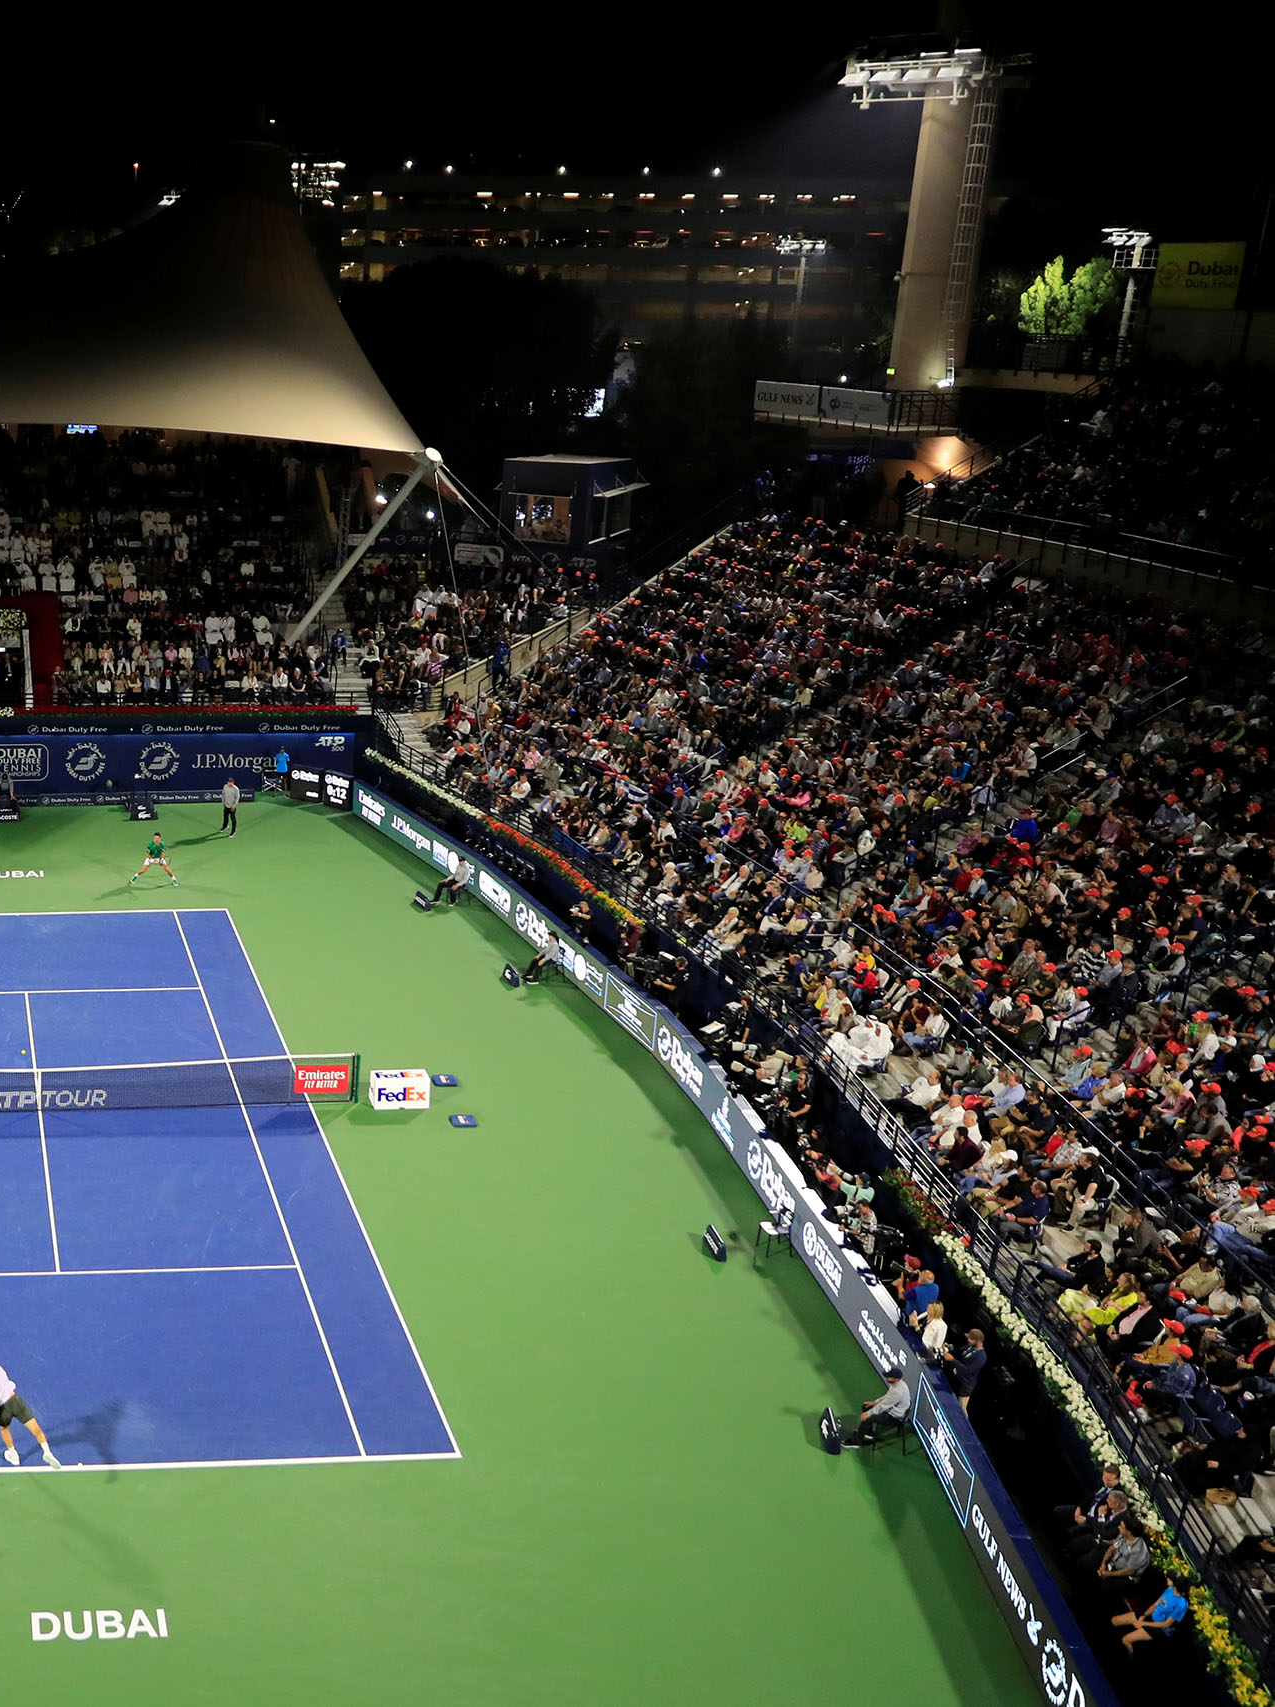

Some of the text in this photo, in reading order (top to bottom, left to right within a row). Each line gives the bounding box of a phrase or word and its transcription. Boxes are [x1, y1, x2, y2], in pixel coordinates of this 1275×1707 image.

[1188, 261, 1238, 275] Dubai
[758, 392, 803, 405] GULF NEWS
[69, 726, 87, 734] Duty
[315, 736, 345, 747] ATP
[298, 1070, 346, 1080] Emirates
[304, 1080, 338, 1088] FLY BETTER
[42, 1089, 107, 1108] TOUR
[377, 1087, 427, 1102] FedEx
[815, 1242, 841, 1288] DUBAI
[971, 1503, 1026, 1620] GULF NEWS
[30, 1608, 169, 1642] DUBAI
